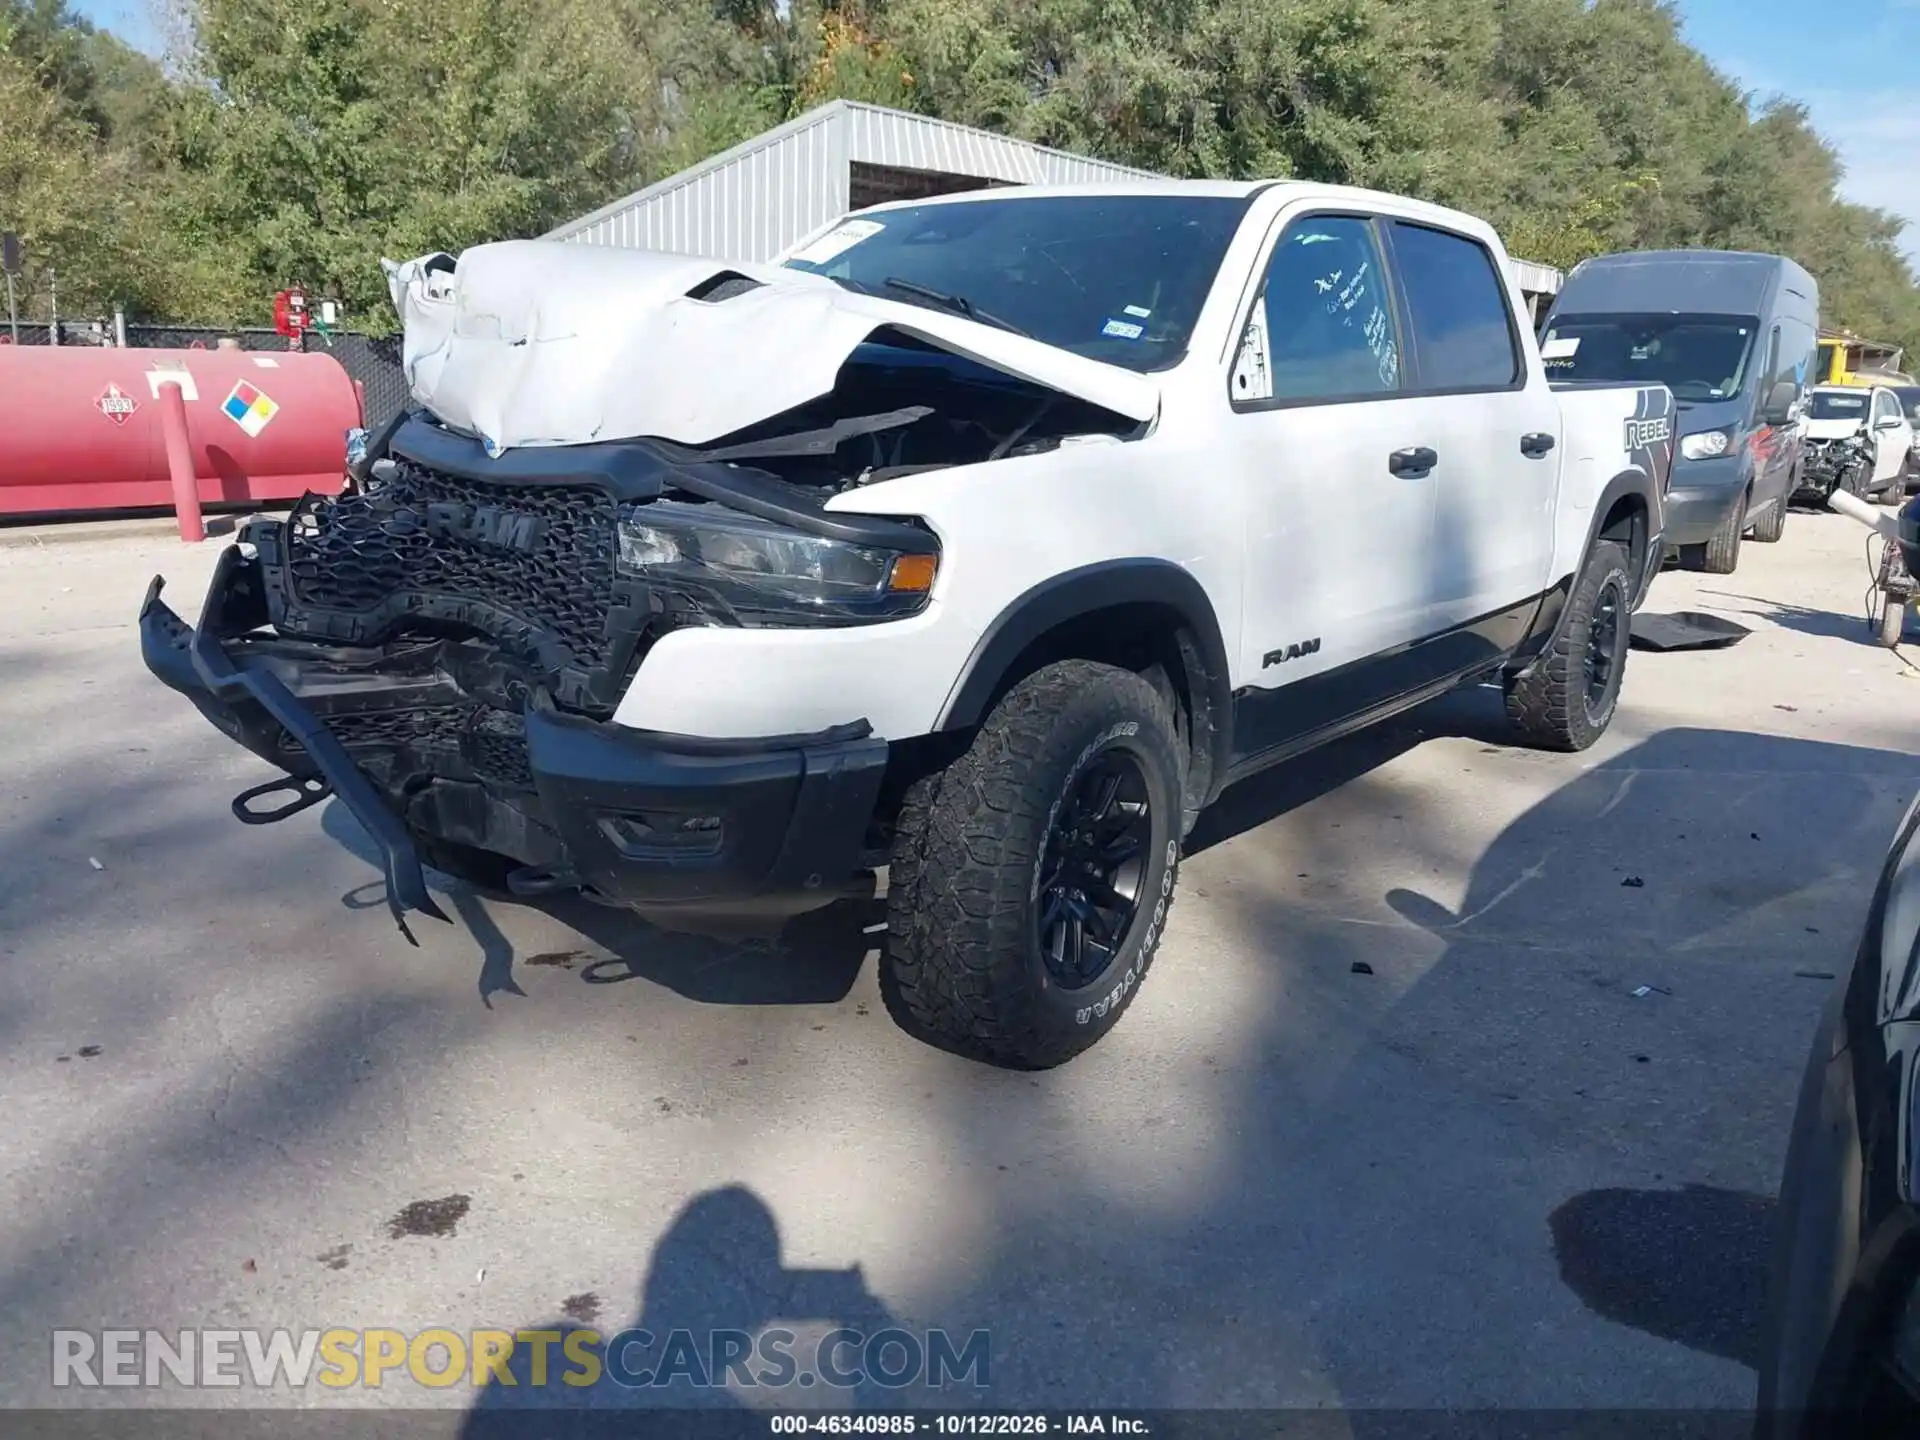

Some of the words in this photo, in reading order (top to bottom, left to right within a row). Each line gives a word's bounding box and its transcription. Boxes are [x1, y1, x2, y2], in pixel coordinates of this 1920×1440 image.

[1623, 417, 1670, 453] REBEL
[428, 501, 540, 552] RAM
[1262, 637, 1321, 669] RAM
[1076, 839, 1177, 1024] GOODYEAR
